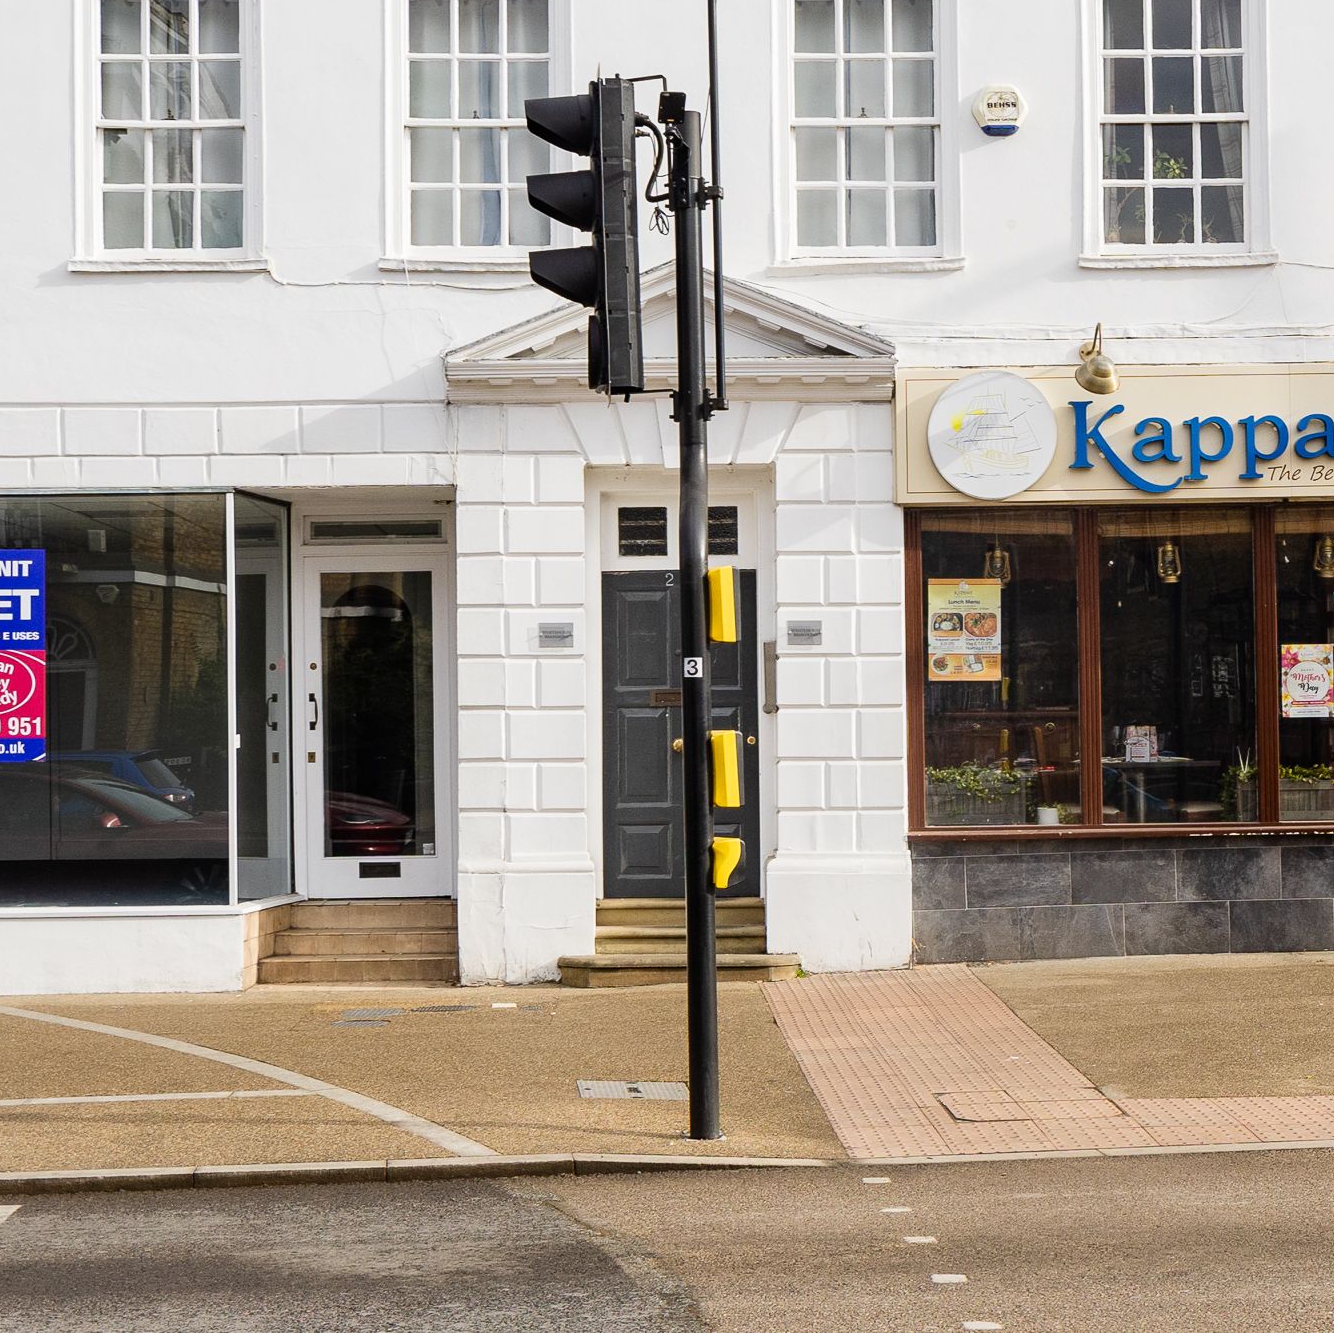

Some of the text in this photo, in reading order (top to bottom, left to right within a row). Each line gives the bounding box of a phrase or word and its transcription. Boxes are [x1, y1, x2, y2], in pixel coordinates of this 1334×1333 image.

[1267, 465, 1302, 482] The
[665, 572, 674, 586] 2
[3, 632, 10, 641] E
[12, 632, 40, 641] USES
[686, 659, 699, 676] 3
[8, 717, 42, 736] 951
